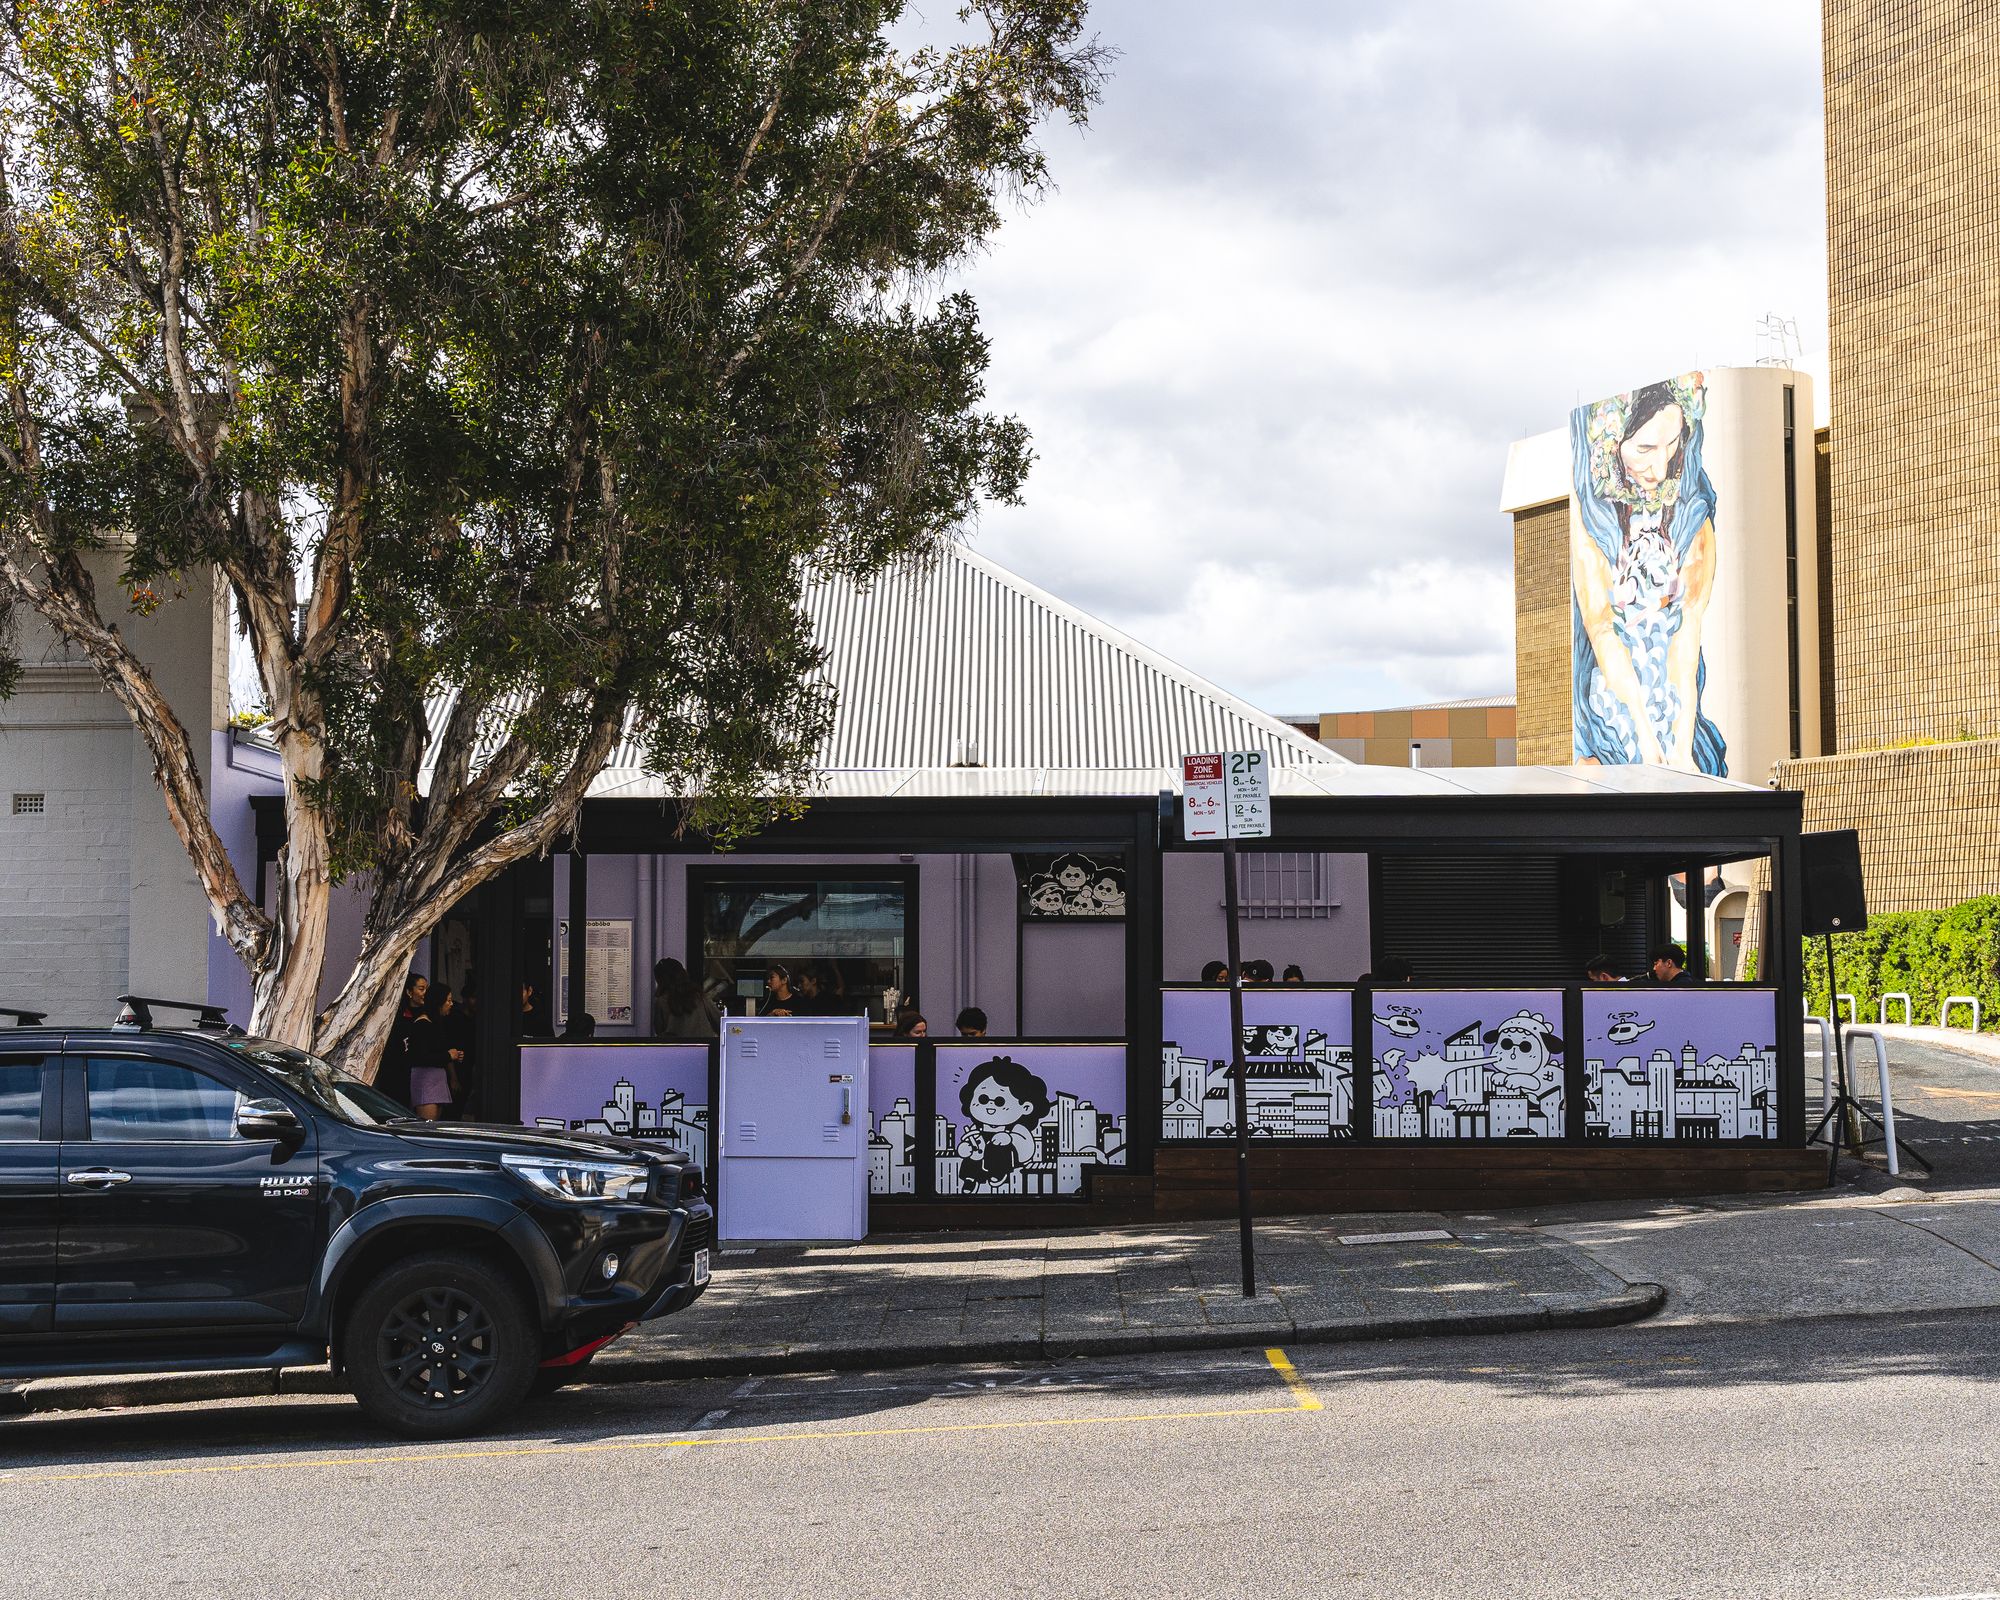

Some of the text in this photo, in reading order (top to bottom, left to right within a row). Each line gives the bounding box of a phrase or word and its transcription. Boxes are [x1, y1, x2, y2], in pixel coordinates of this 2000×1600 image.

[1187, 756, 1219, 766] LOADING
[1231, 752, 1261, 774] 2P
[1193, 765, 1213, 774] ZONE
[259, 1175, 314, 1188] HILUX
